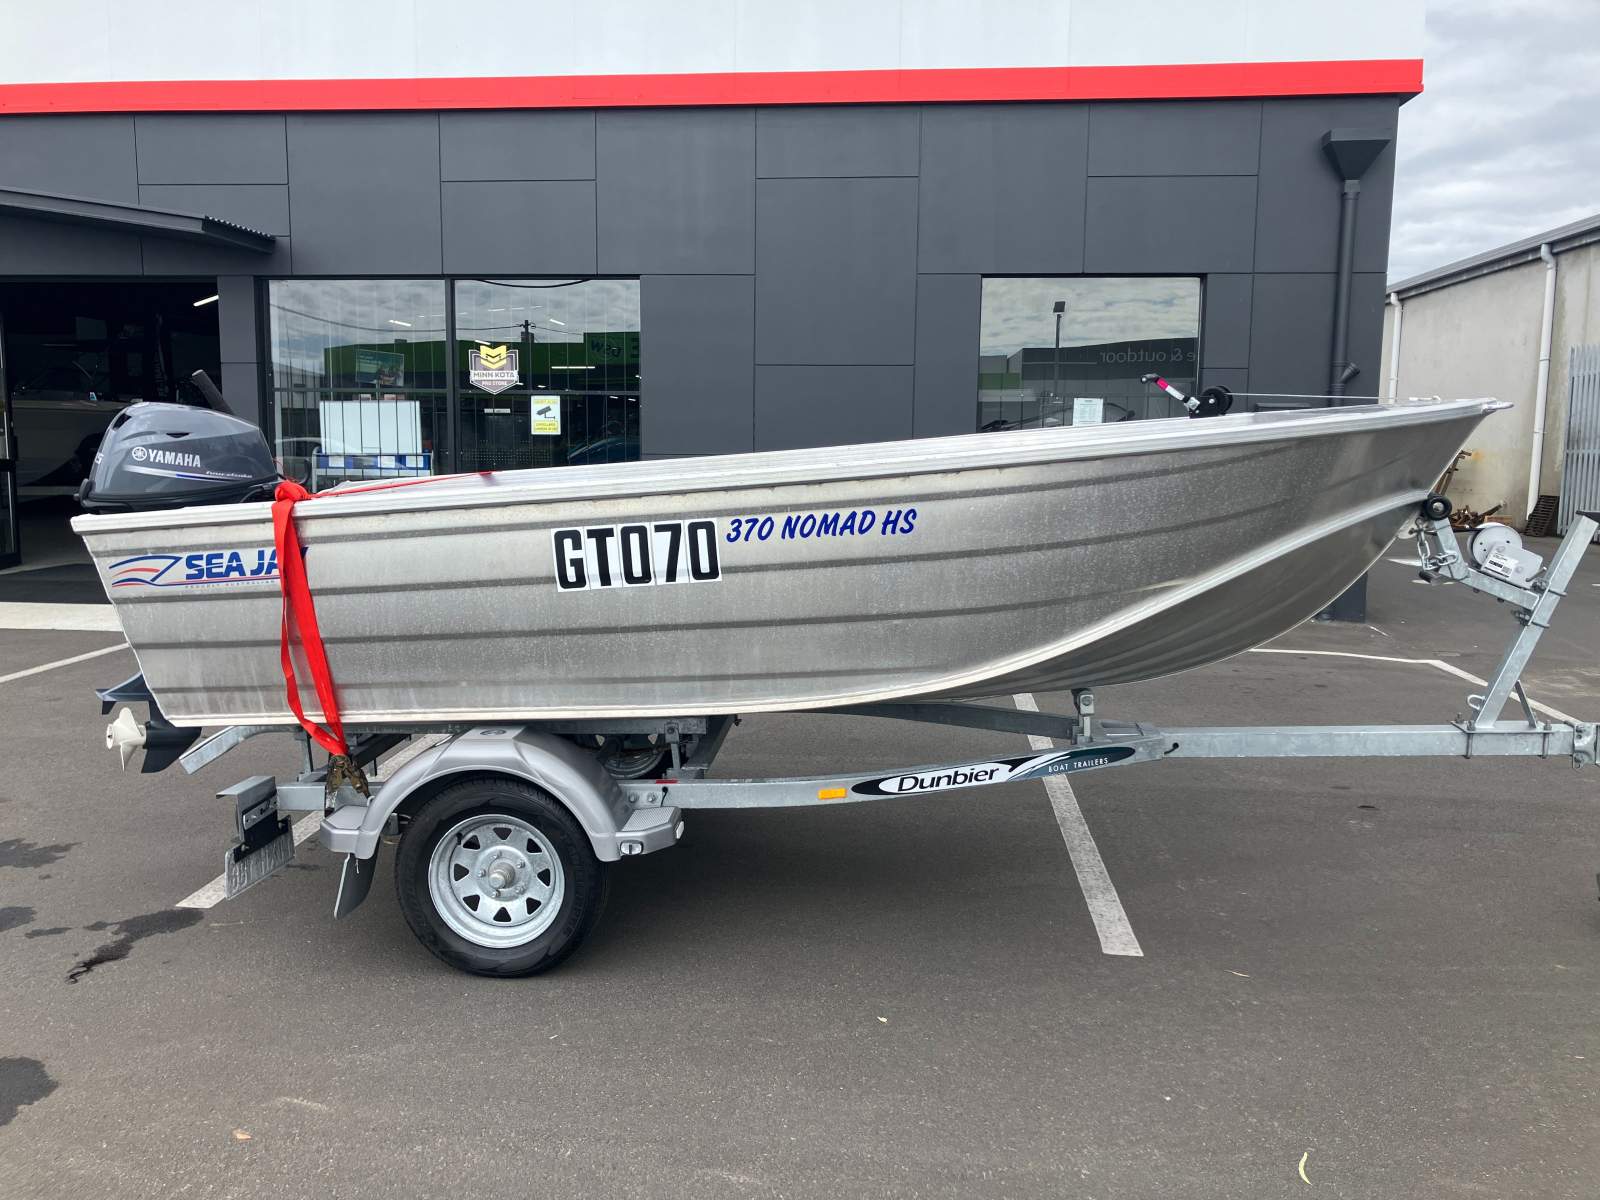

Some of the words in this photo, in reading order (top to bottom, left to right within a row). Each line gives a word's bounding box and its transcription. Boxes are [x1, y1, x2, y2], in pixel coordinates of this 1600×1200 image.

[148, 449, 201, 468] YAMAHA
[726, 516, 775, 543] 370
[781, 511, 876, 540] NOMAD
[881, 508, 918, 536] HS
[185, 551, 247, 580] SEA
[553, 520, 720, 589] GT070
[1048, 762, 1069, 773] BOAT
[1073, 757, 1109, 770] TRAILERS
[896, 767, 1000, 793] Dunbier
